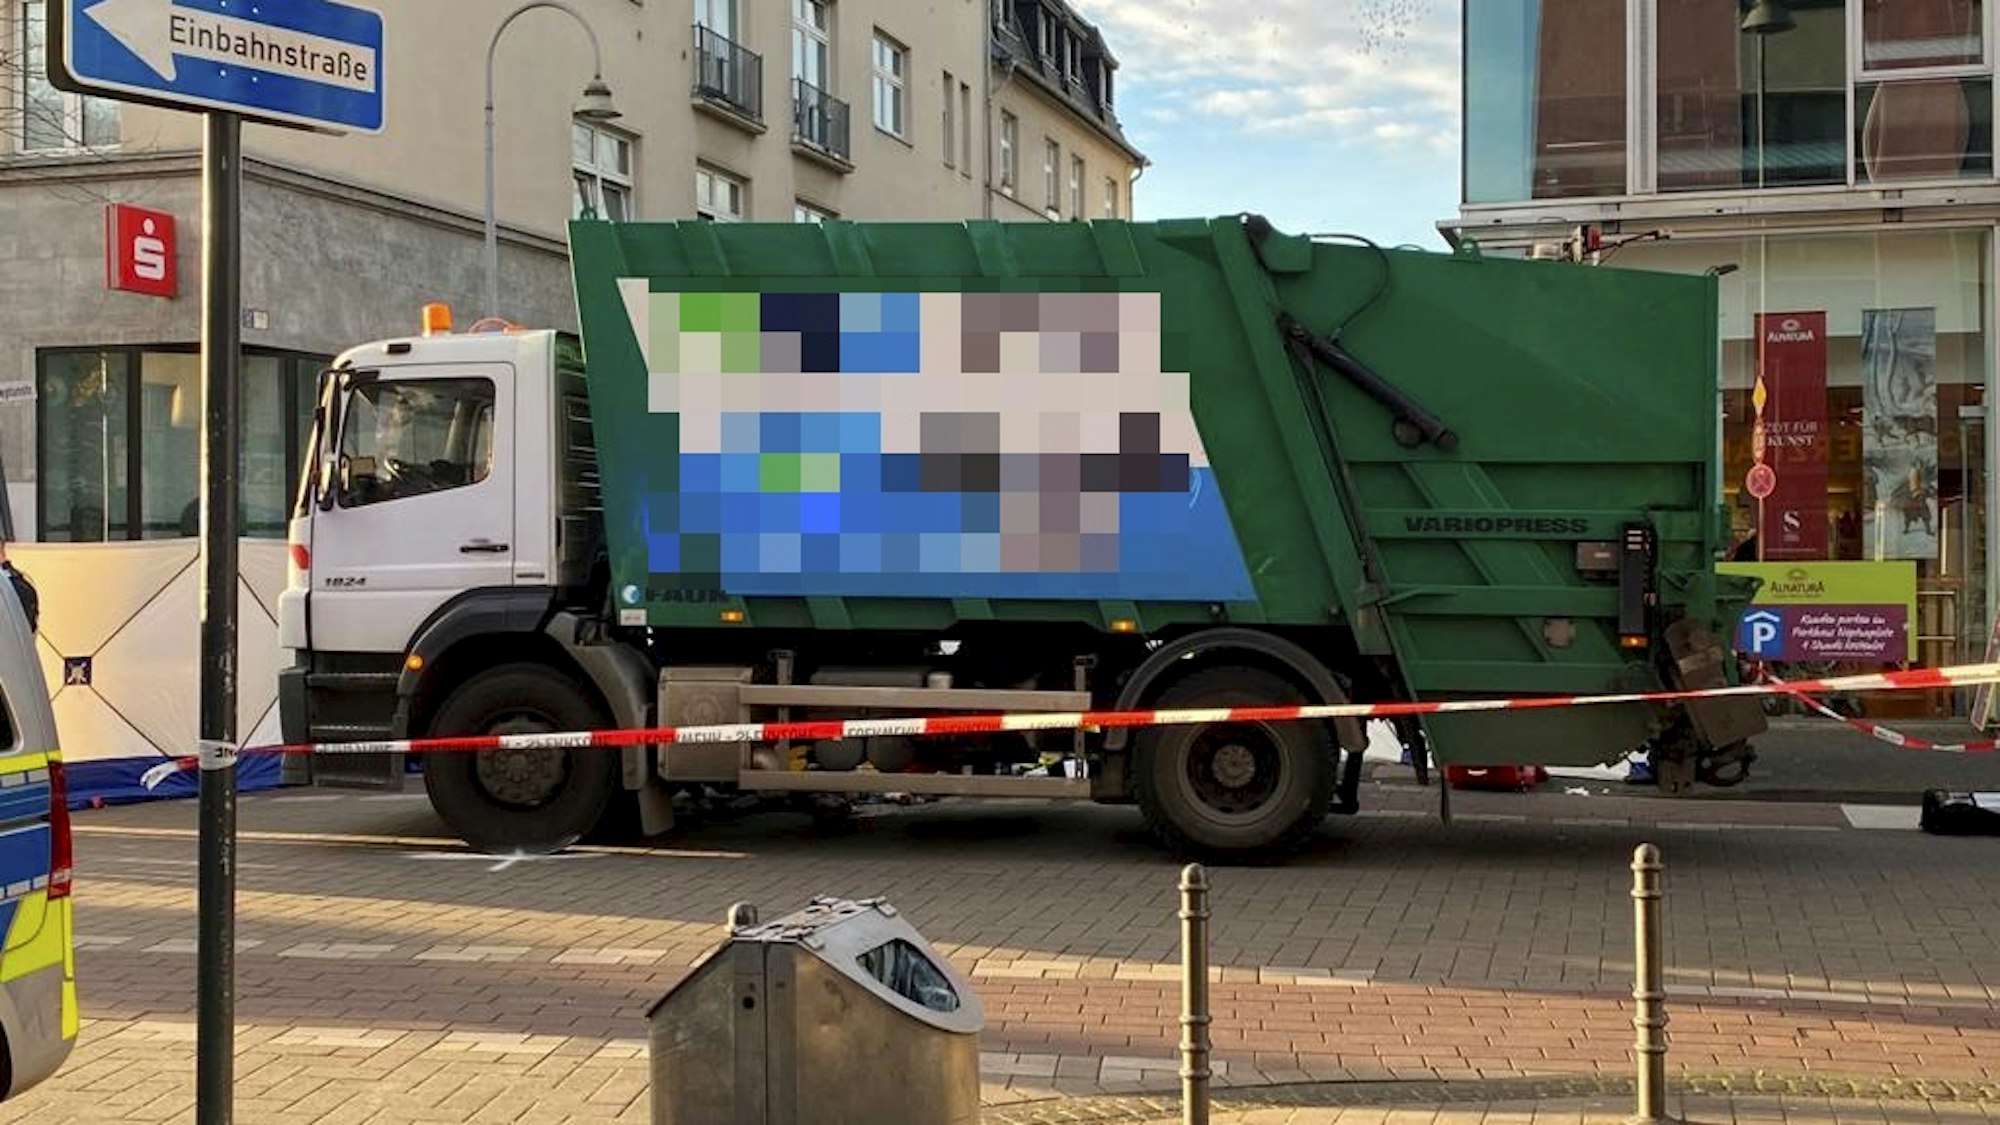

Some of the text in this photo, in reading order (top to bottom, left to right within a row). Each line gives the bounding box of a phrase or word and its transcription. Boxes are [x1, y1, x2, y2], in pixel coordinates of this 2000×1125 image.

[169, 14, 368, 81] Einbahnstraße
[1767, 435, 1814, 447] KUNST
[1405, 516, 1589, 534] VARIOPRESS
[325, 577, 367, 587] 1824
[1753, 622, 1776, 653] P
